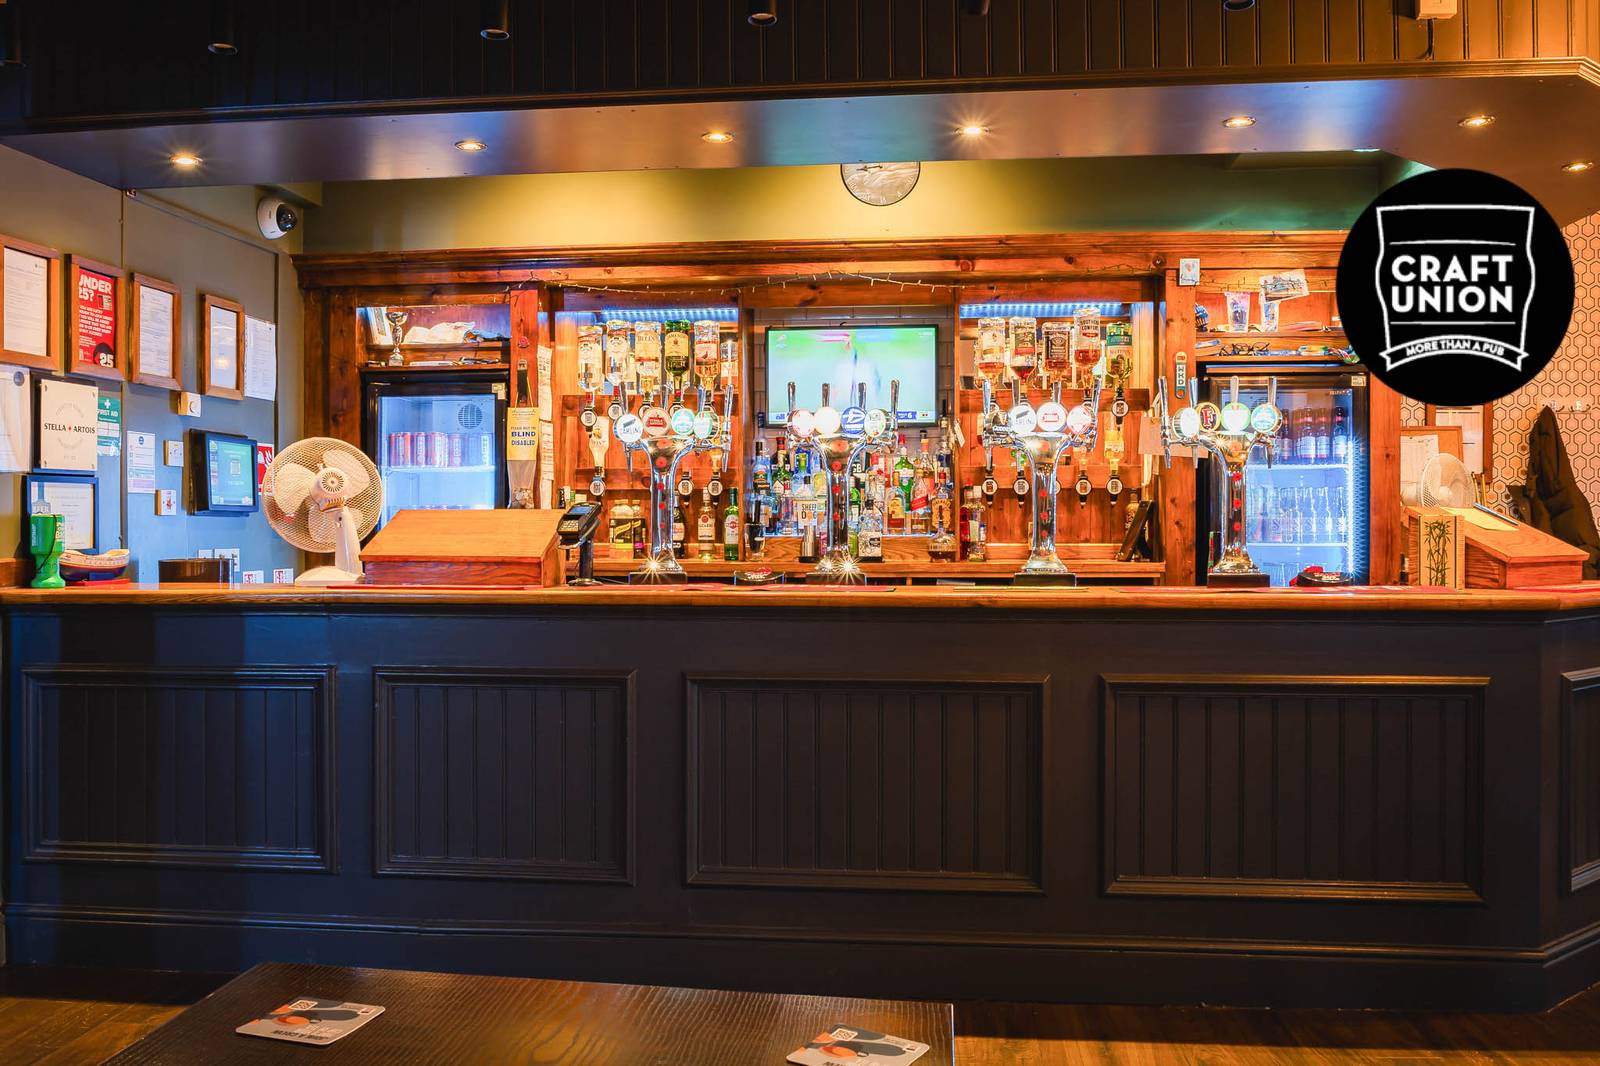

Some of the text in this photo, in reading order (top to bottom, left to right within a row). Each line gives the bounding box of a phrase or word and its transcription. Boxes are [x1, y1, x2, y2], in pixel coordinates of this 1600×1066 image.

[100, 353, 114, 368] 25
[44, 423, 96, 434] STELLA ARTOIS
